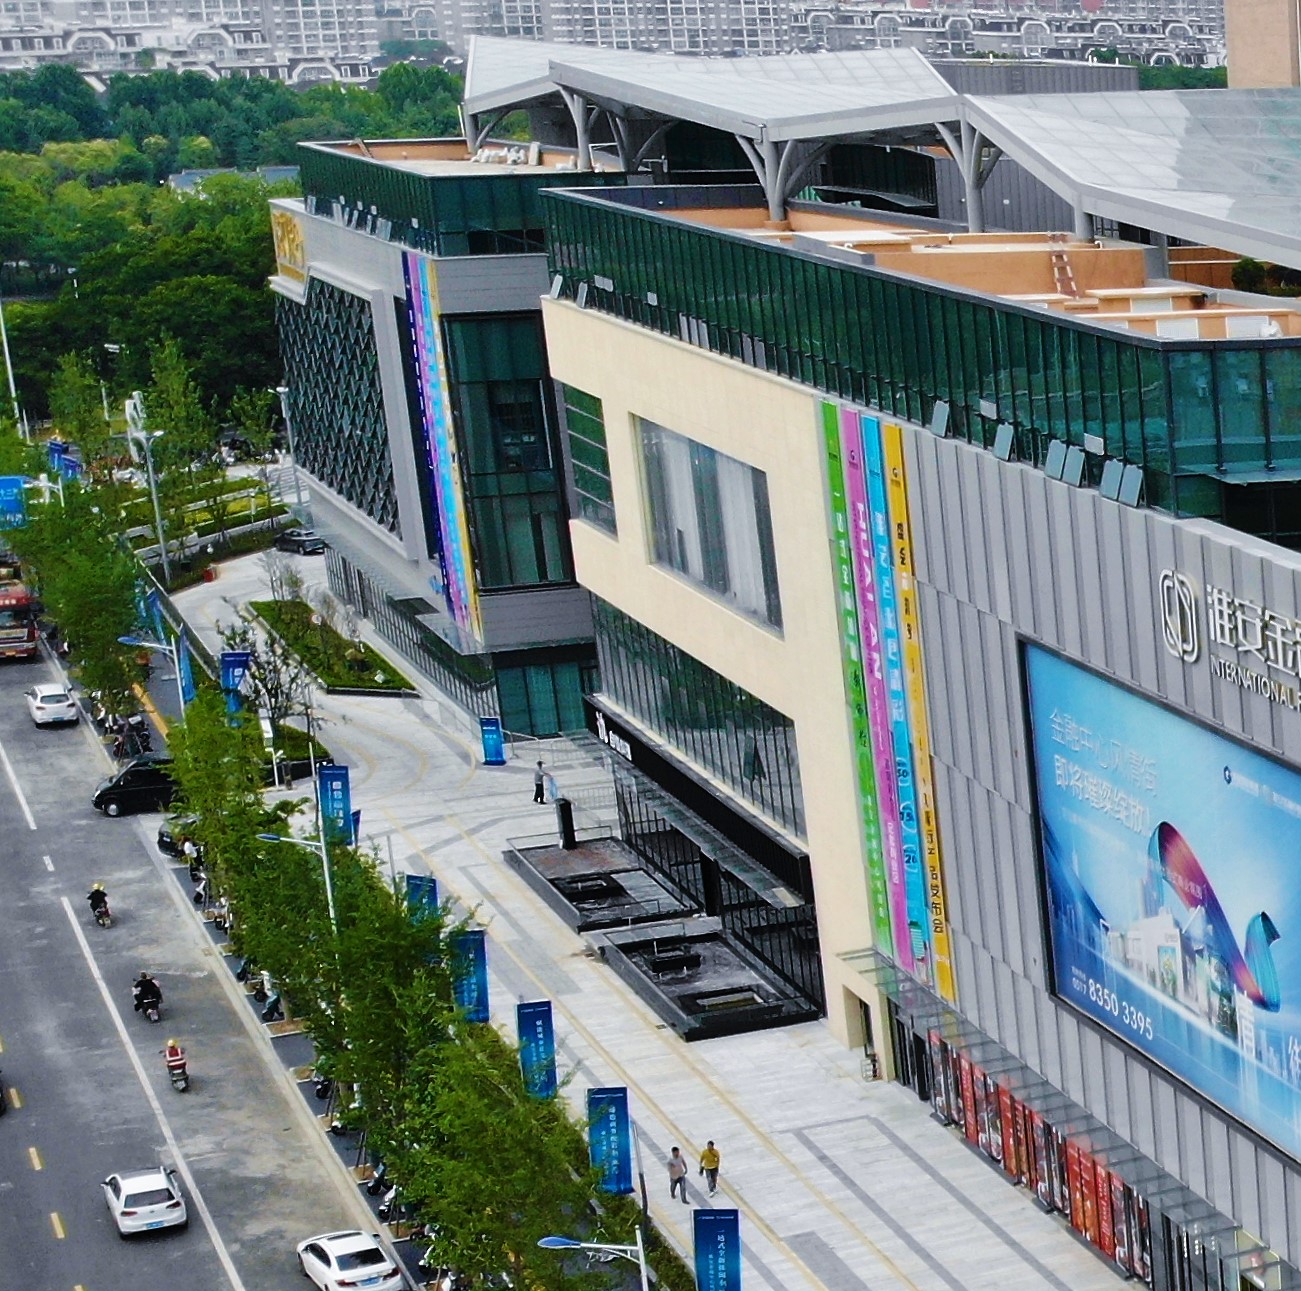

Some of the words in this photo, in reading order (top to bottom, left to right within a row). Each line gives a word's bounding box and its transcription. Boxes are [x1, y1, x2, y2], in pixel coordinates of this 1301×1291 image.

[1210, 655, 1297, 710] INTERNATIONAL
[1088, 978, 1119, 1017] 8350
[1122, 1001, 1153, 1040] 3395
